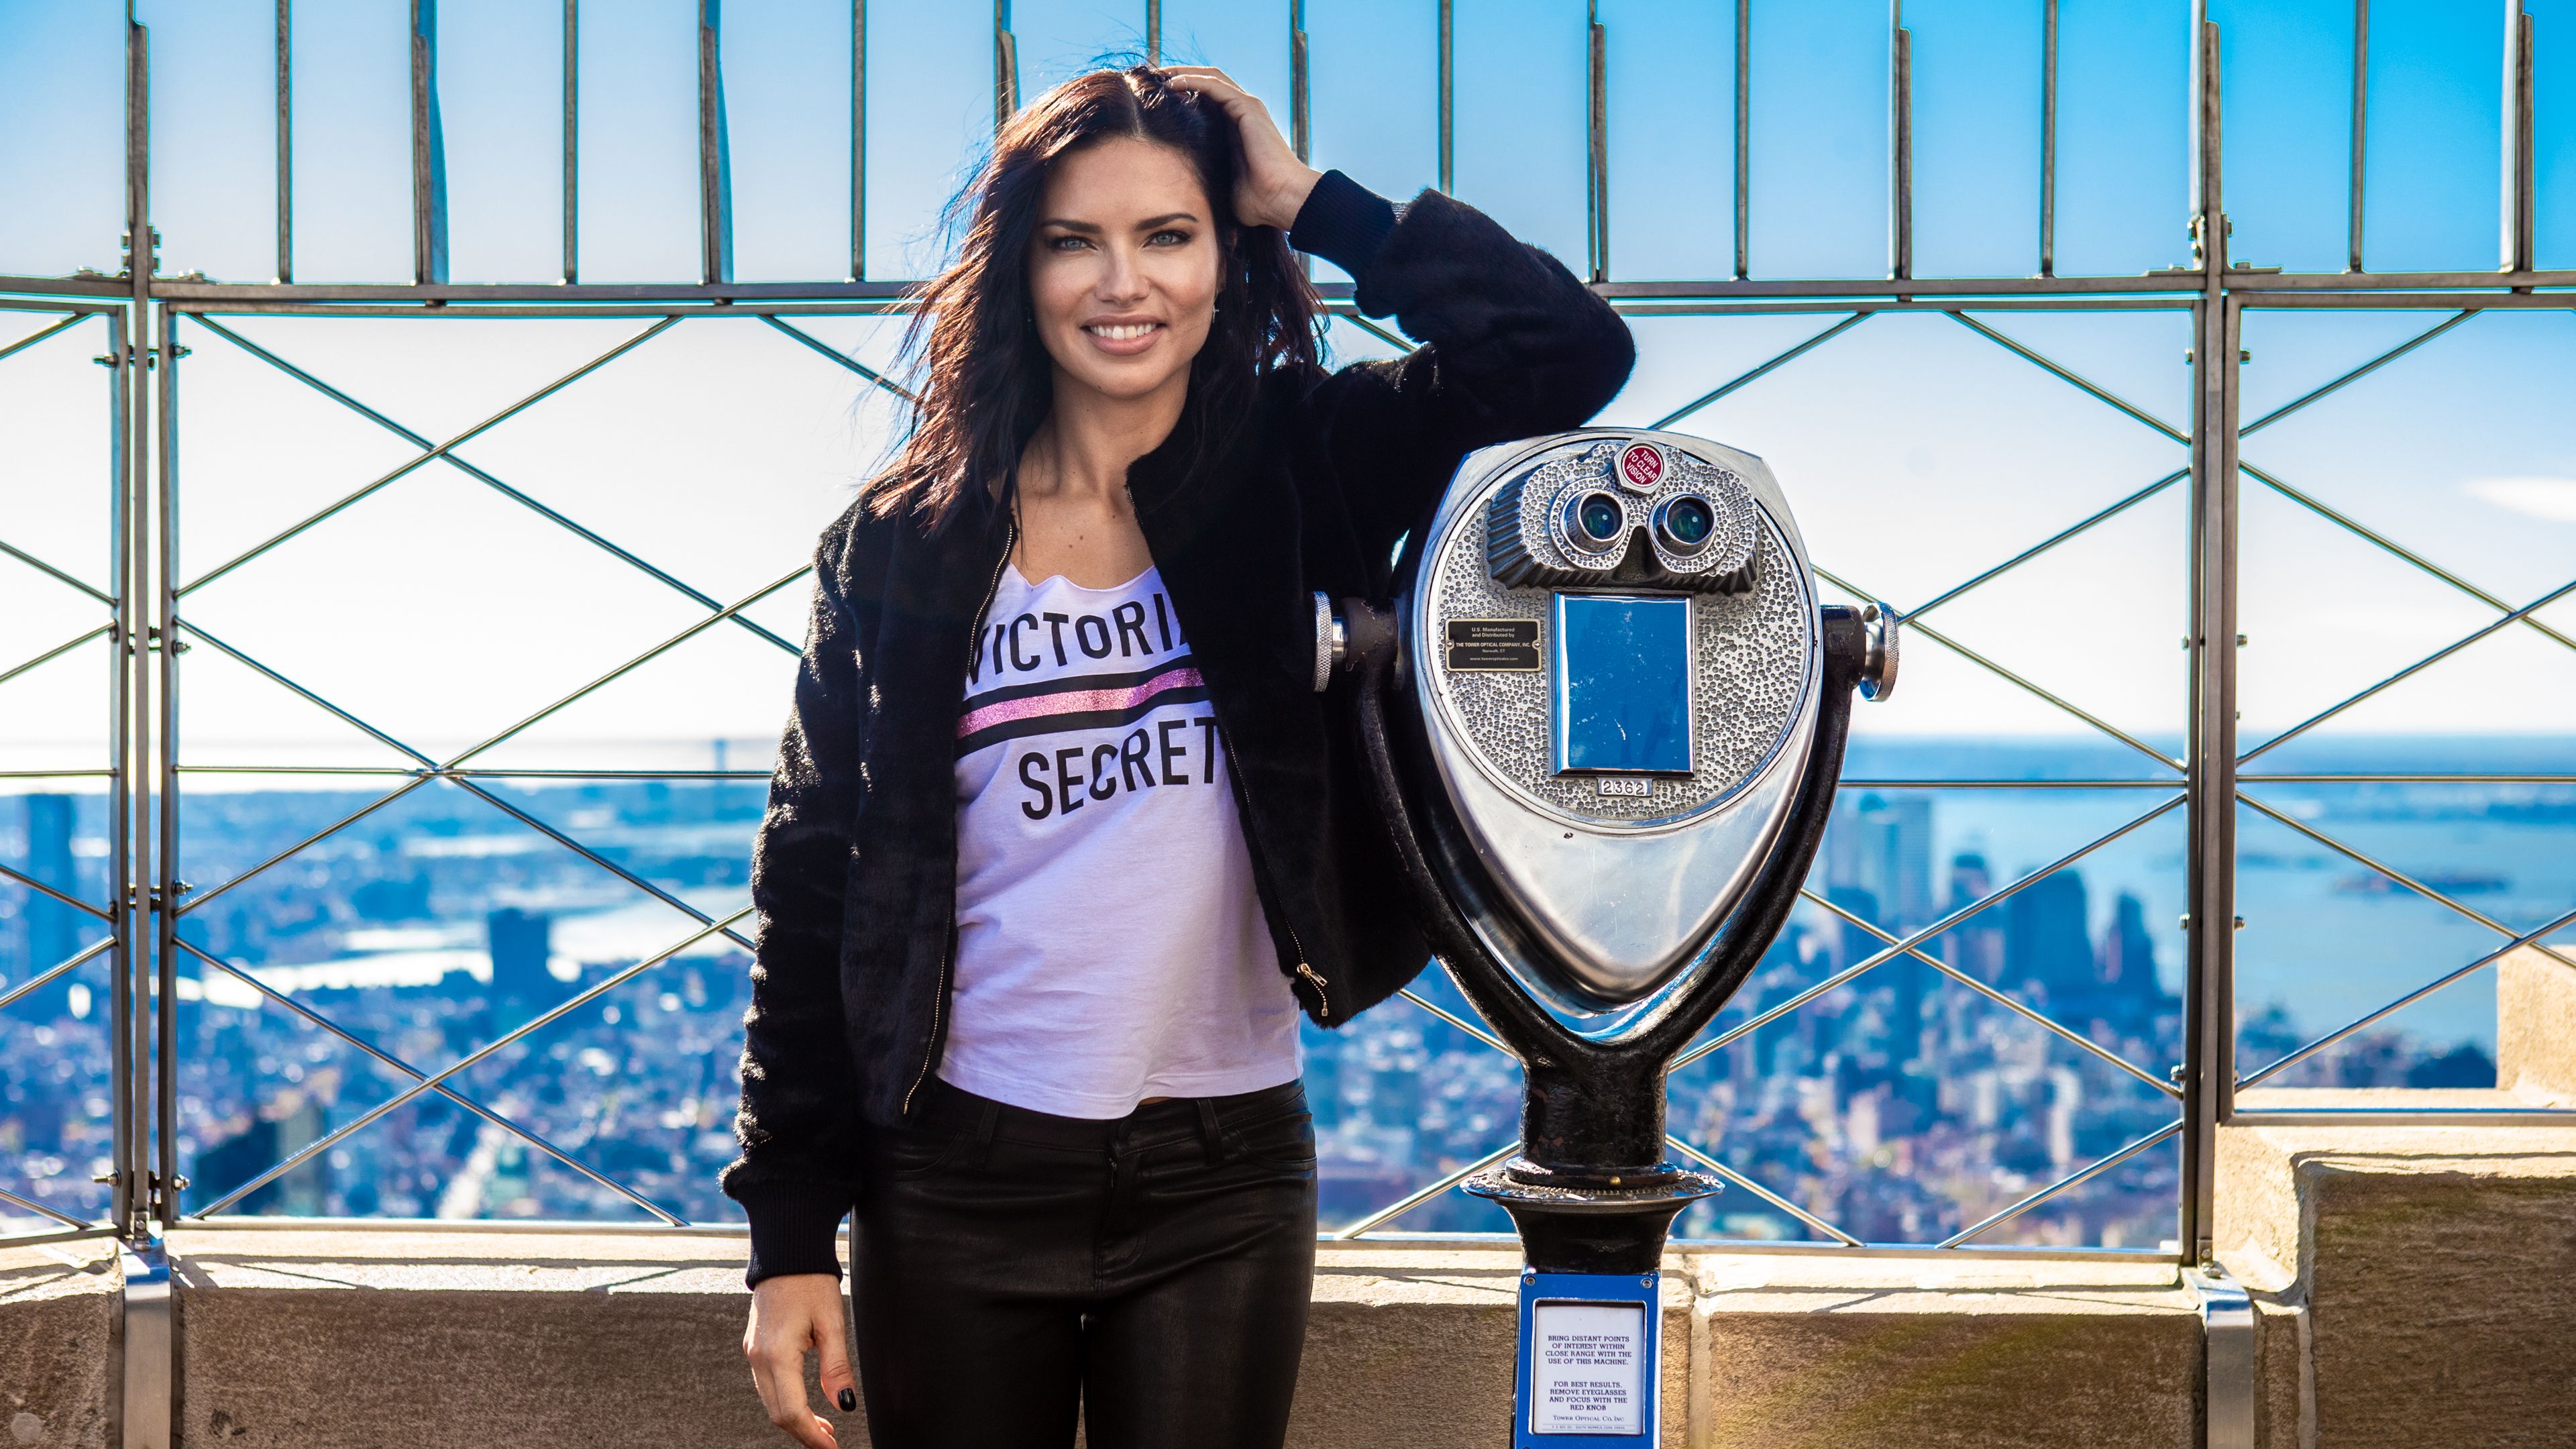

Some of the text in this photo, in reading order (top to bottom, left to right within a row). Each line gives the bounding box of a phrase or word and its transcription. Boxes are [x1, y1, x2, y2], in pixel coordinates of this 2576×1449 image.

[1629, 451, 1657, 481] TO CLEAR
[1641, 450, 1658, 468] TURN
[1626, 462, 1647, 484] VISION
[969, 592, 1187, 685] VICTORI
[1018, 716, 1218, 820] SECRET
[1603, 781, 1644, 795] 2362
